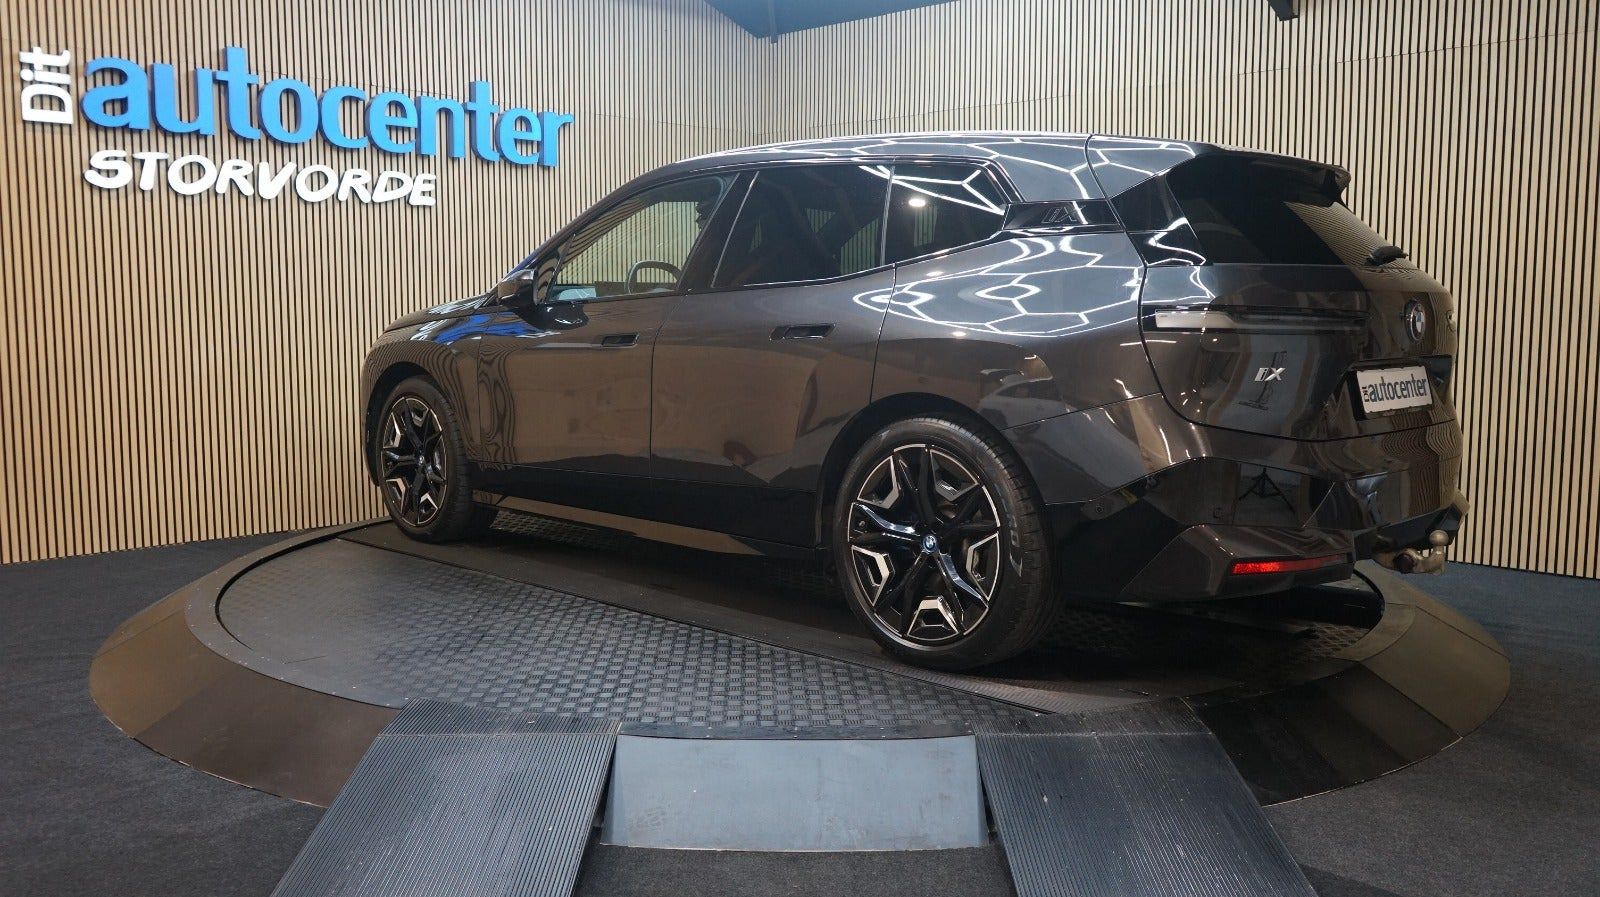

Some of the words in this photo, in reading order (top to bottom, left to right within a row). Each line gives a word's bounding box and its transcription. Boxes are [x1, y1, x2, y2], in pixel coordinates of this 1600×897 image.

[19, 46, 74, 125] Dit
[81, 46, 574, 168] autocenter
[84, 149, 437, 207] STORVORDE
[1368, 374, 1427, 402] autocenter
